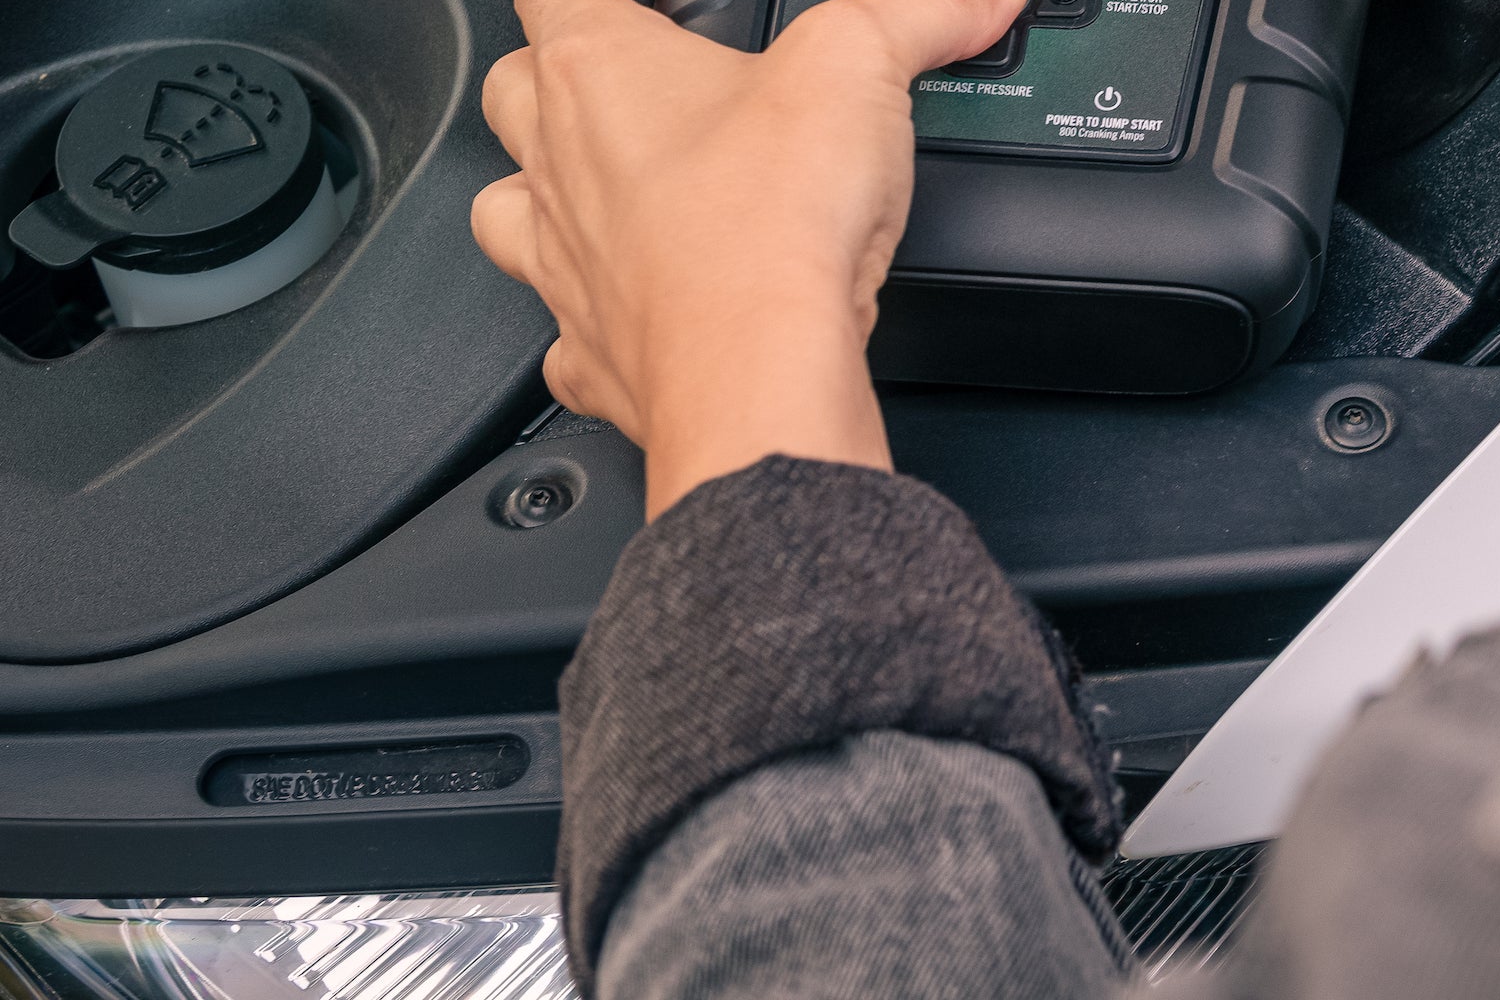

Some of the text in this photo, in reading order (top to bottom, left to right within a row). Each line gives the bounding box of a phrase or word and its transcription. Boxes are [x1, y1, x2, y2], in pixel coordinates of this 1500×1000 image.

[1105, 1, 1169, 15] START/STOP
[918, 80, 1034, 97] DECREASE PRESSURE
[1045, 114, 1163, 131] POWER TO JUMP START
[1058, 126, 1145, 142] 800 Cranking Amps
